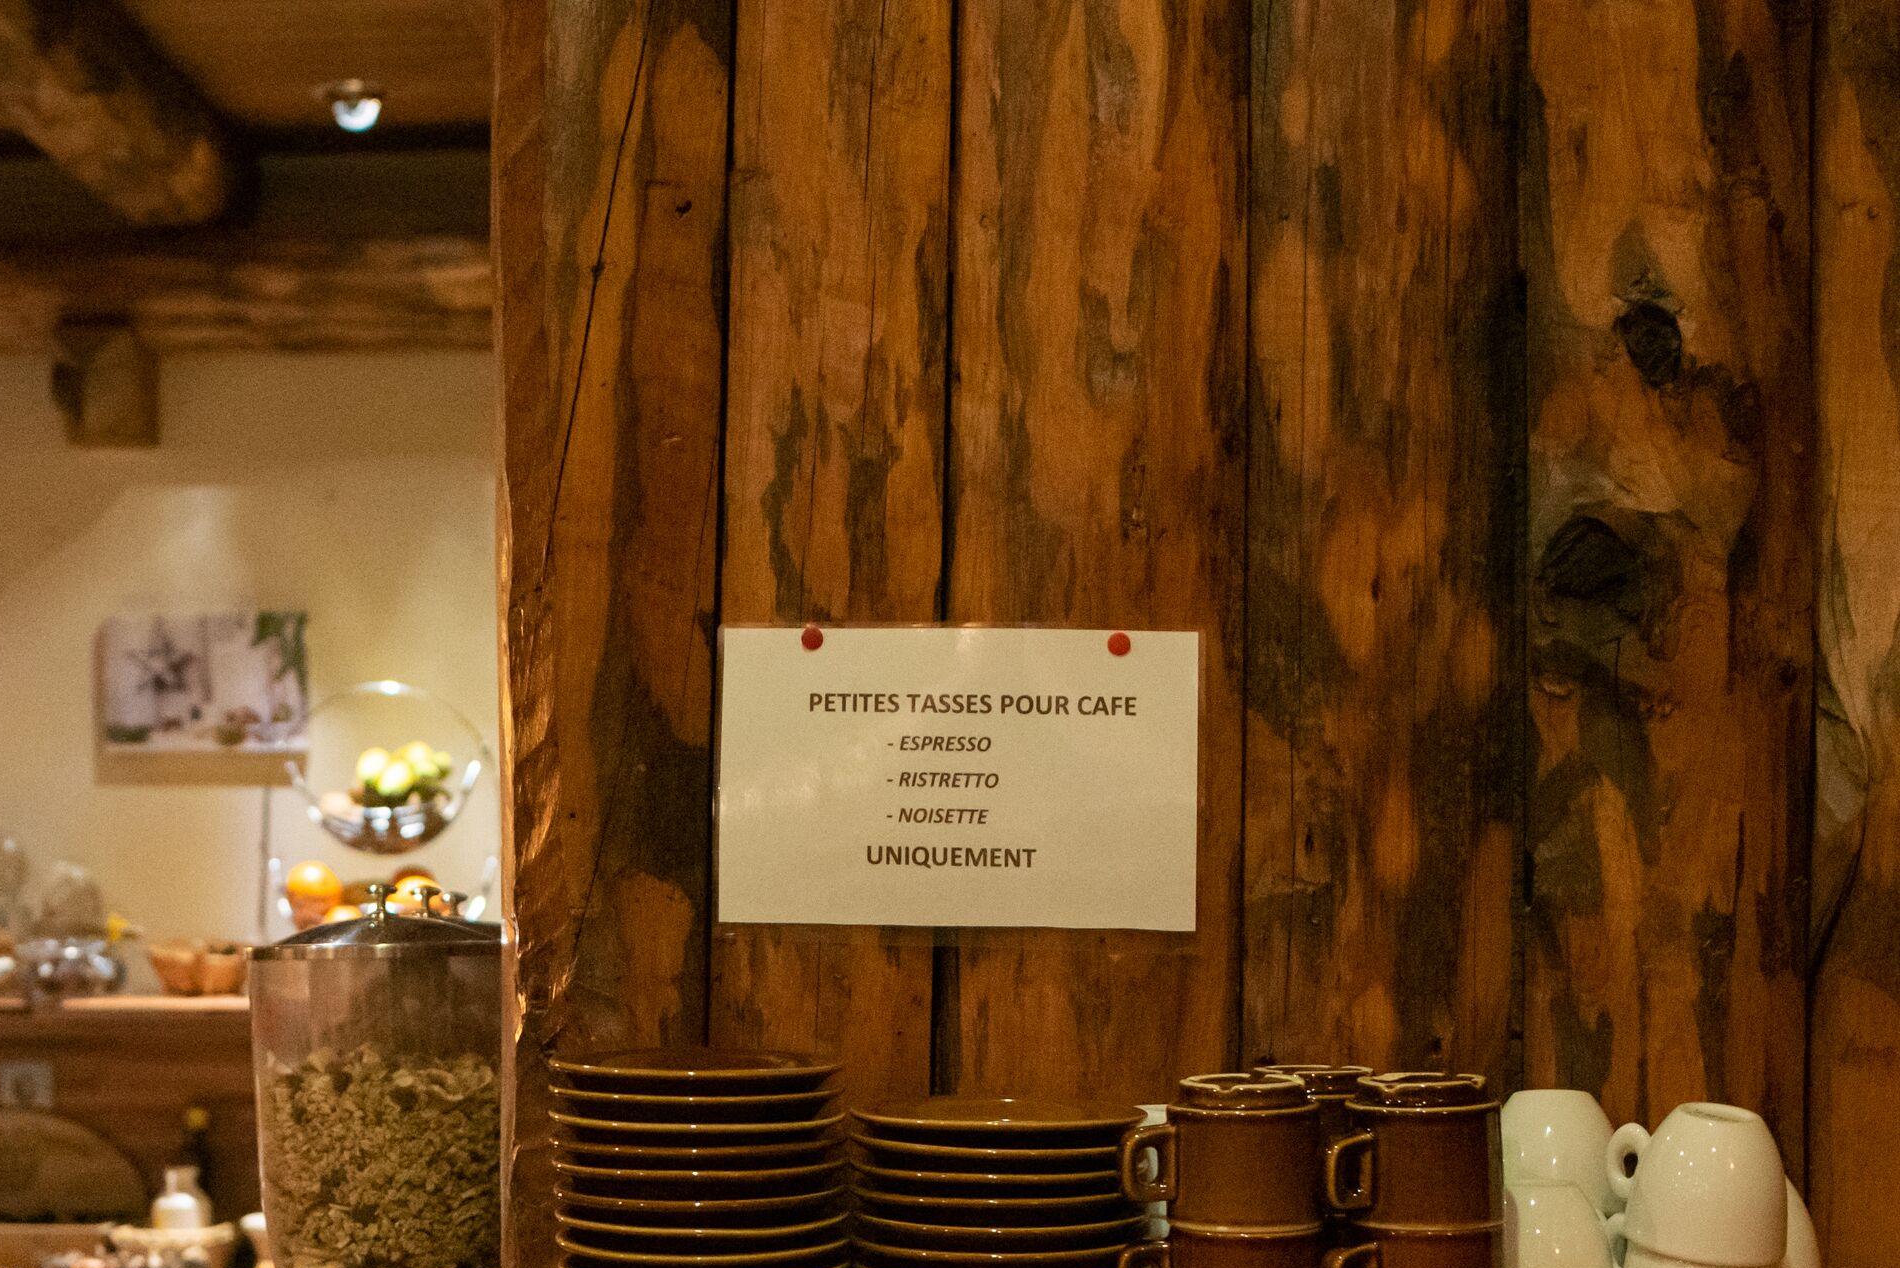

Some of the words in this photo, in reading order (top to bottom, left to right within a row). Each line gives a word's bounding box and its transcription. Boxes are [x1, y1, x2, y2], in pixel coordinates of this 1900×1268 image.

[808, 692, 900, 714] PETITES
[905, 693, 993, 715] TASSES
[1000, 694, 1070, 716] POUR
[1077, 695, 1138, 717] CAFE
[898, 735, 992, 753] ESPRESSO
[898, 771, 1000, 789] RISTRETTO
[898, 807, 989, 825] NOISETTE
[866, 845, 1037, 869] UNIQUEMENT
